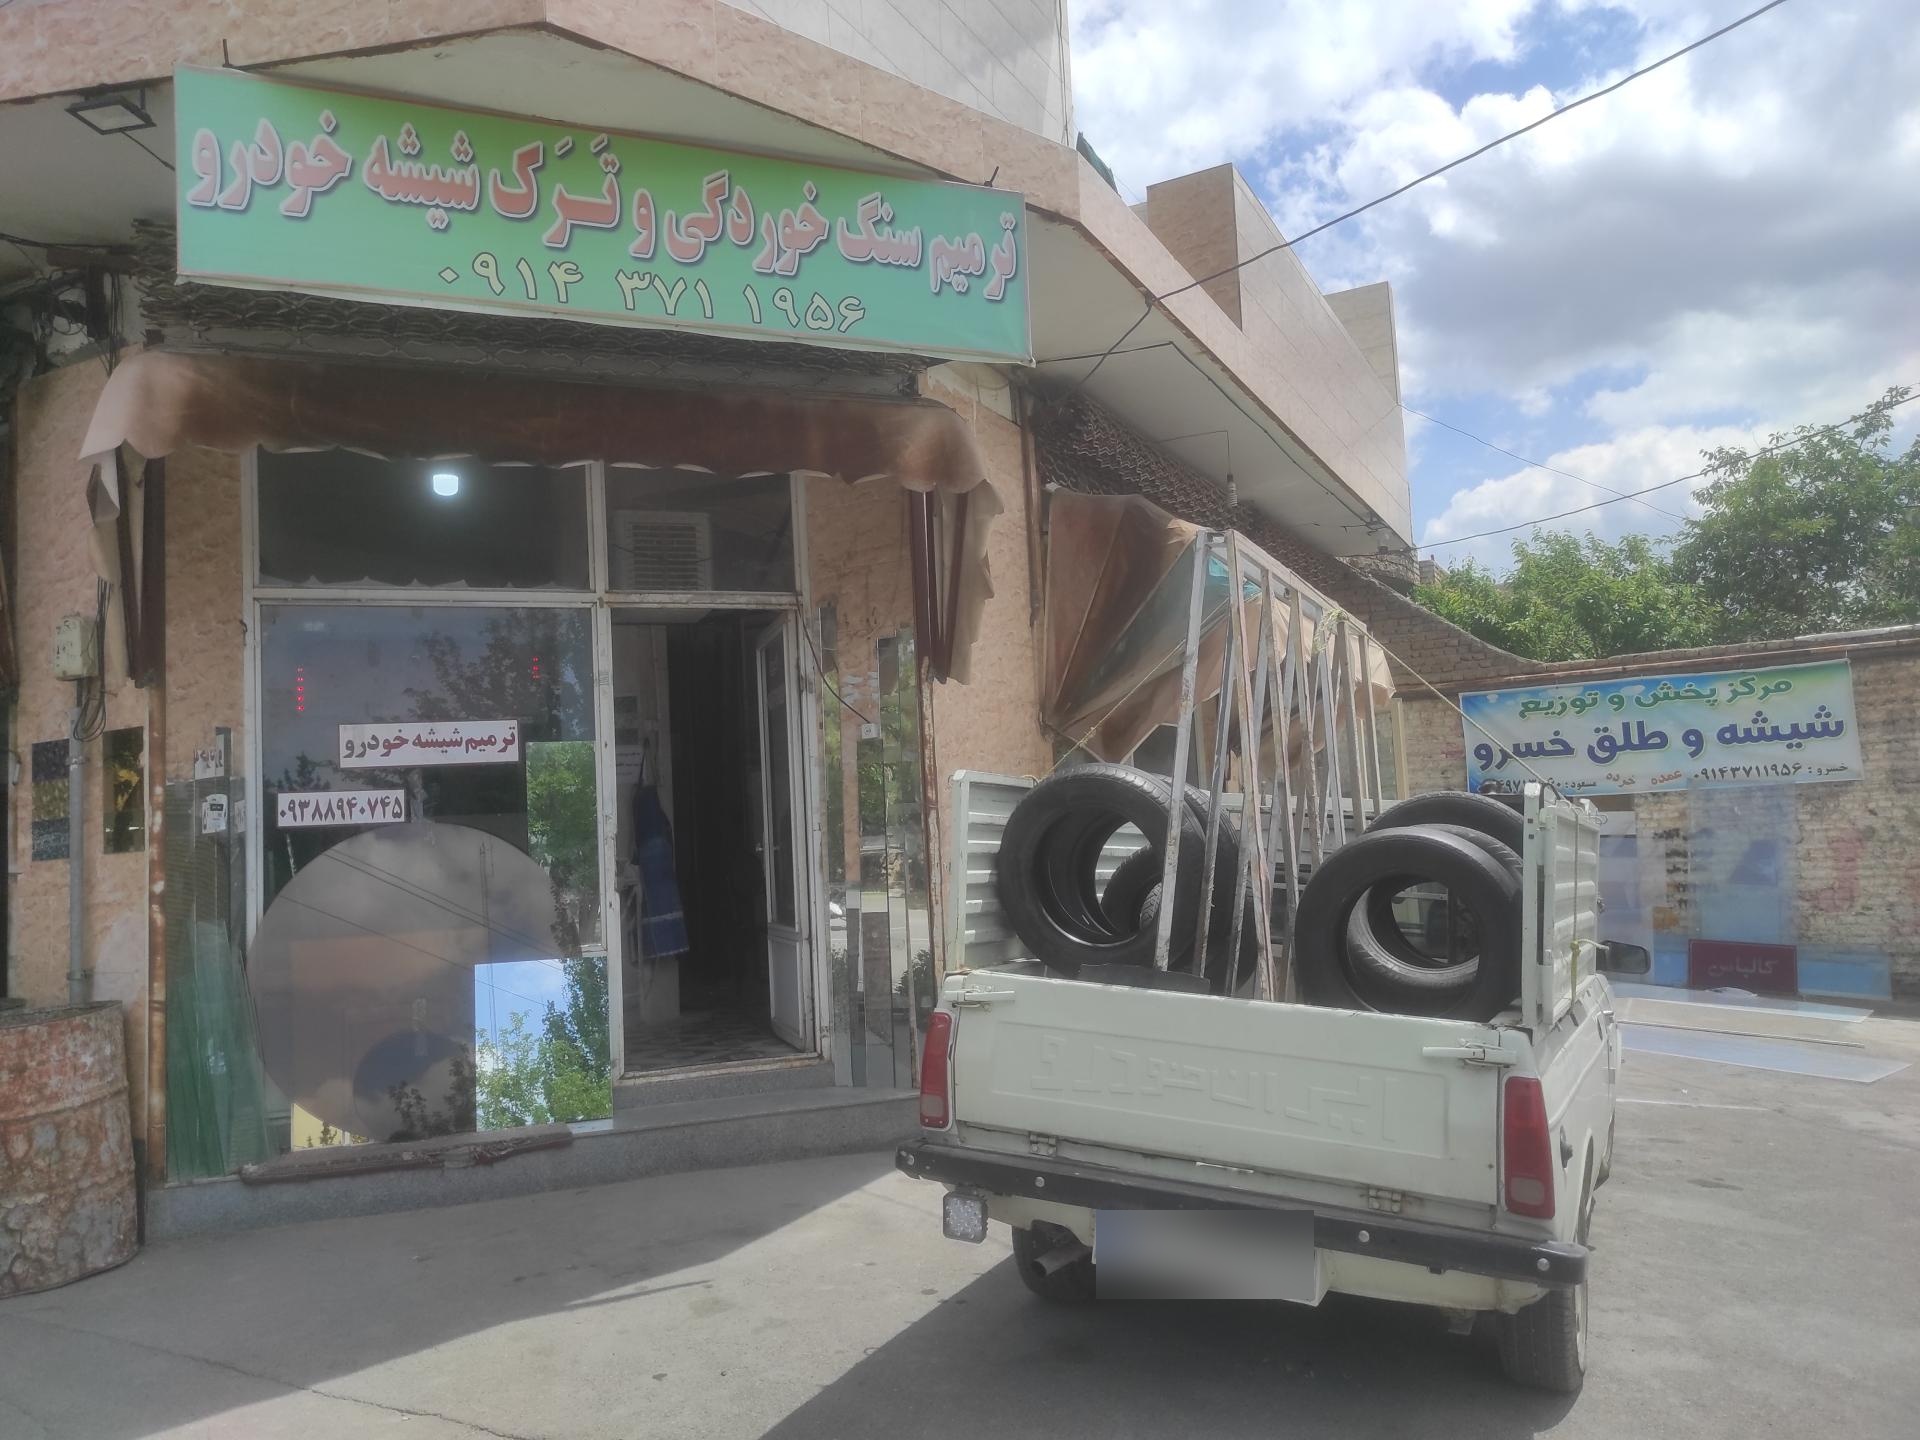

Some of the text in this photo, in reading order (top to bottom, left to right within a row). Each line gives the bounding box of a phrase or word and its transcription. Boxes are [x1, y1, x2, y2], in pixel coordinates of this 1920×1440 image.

[188, 110, 352, 216] خودرو
[363, 122, 480, 230] شیشه
[630, 189, 656, 259] و
[664, 169, 829, 276] خوردگی
[838, 192, 921, 267] سنگ
[930, 212, 1017, 300] ترمیم
[438, 252, 865, 333] ۰۹۱۴ ۳۷۱ ۱۹۵۶
[1519, 676, 1793, 719] مرکز پخش و توزیع
[343, 725, 517, 758] ترمیم شیشه خودرو
[1473, 705, 1844, 772] شیشه و طلق خسرو
[279, 795, 403, 823] ۰۹۳۸۸۹۴۰۷۴۵
